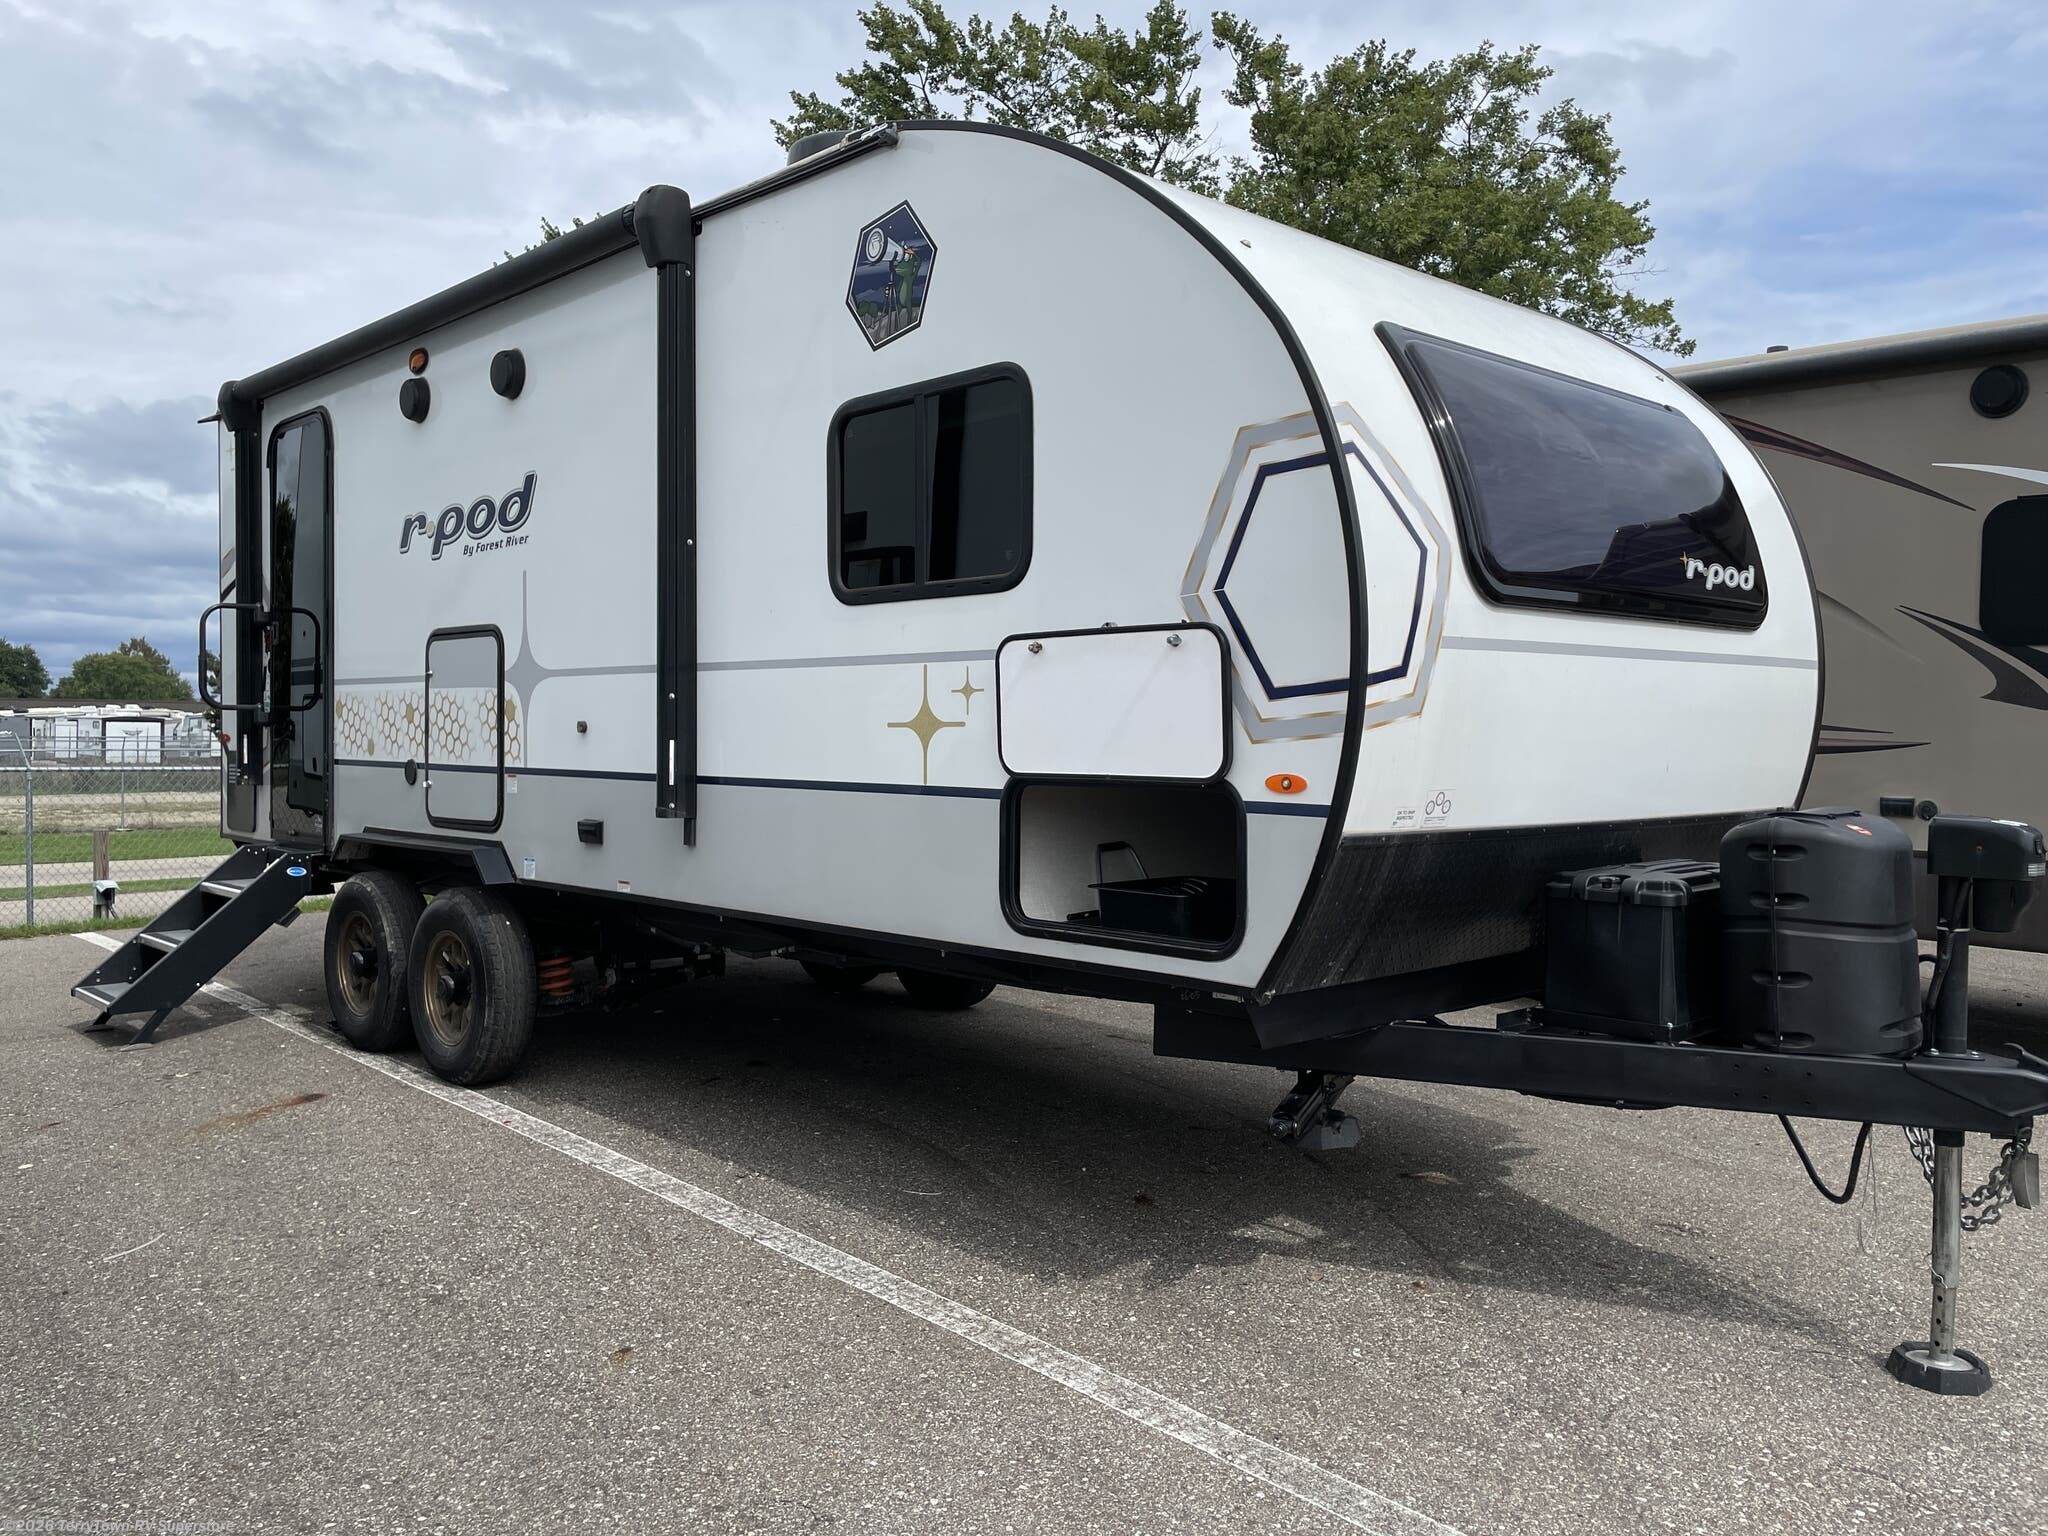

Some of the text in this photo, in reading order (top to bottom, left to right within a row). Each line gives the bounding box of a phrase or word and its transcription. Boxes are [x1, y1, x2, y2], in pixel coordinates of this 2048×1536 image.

[463, 535, 529, 556] By Forest River
